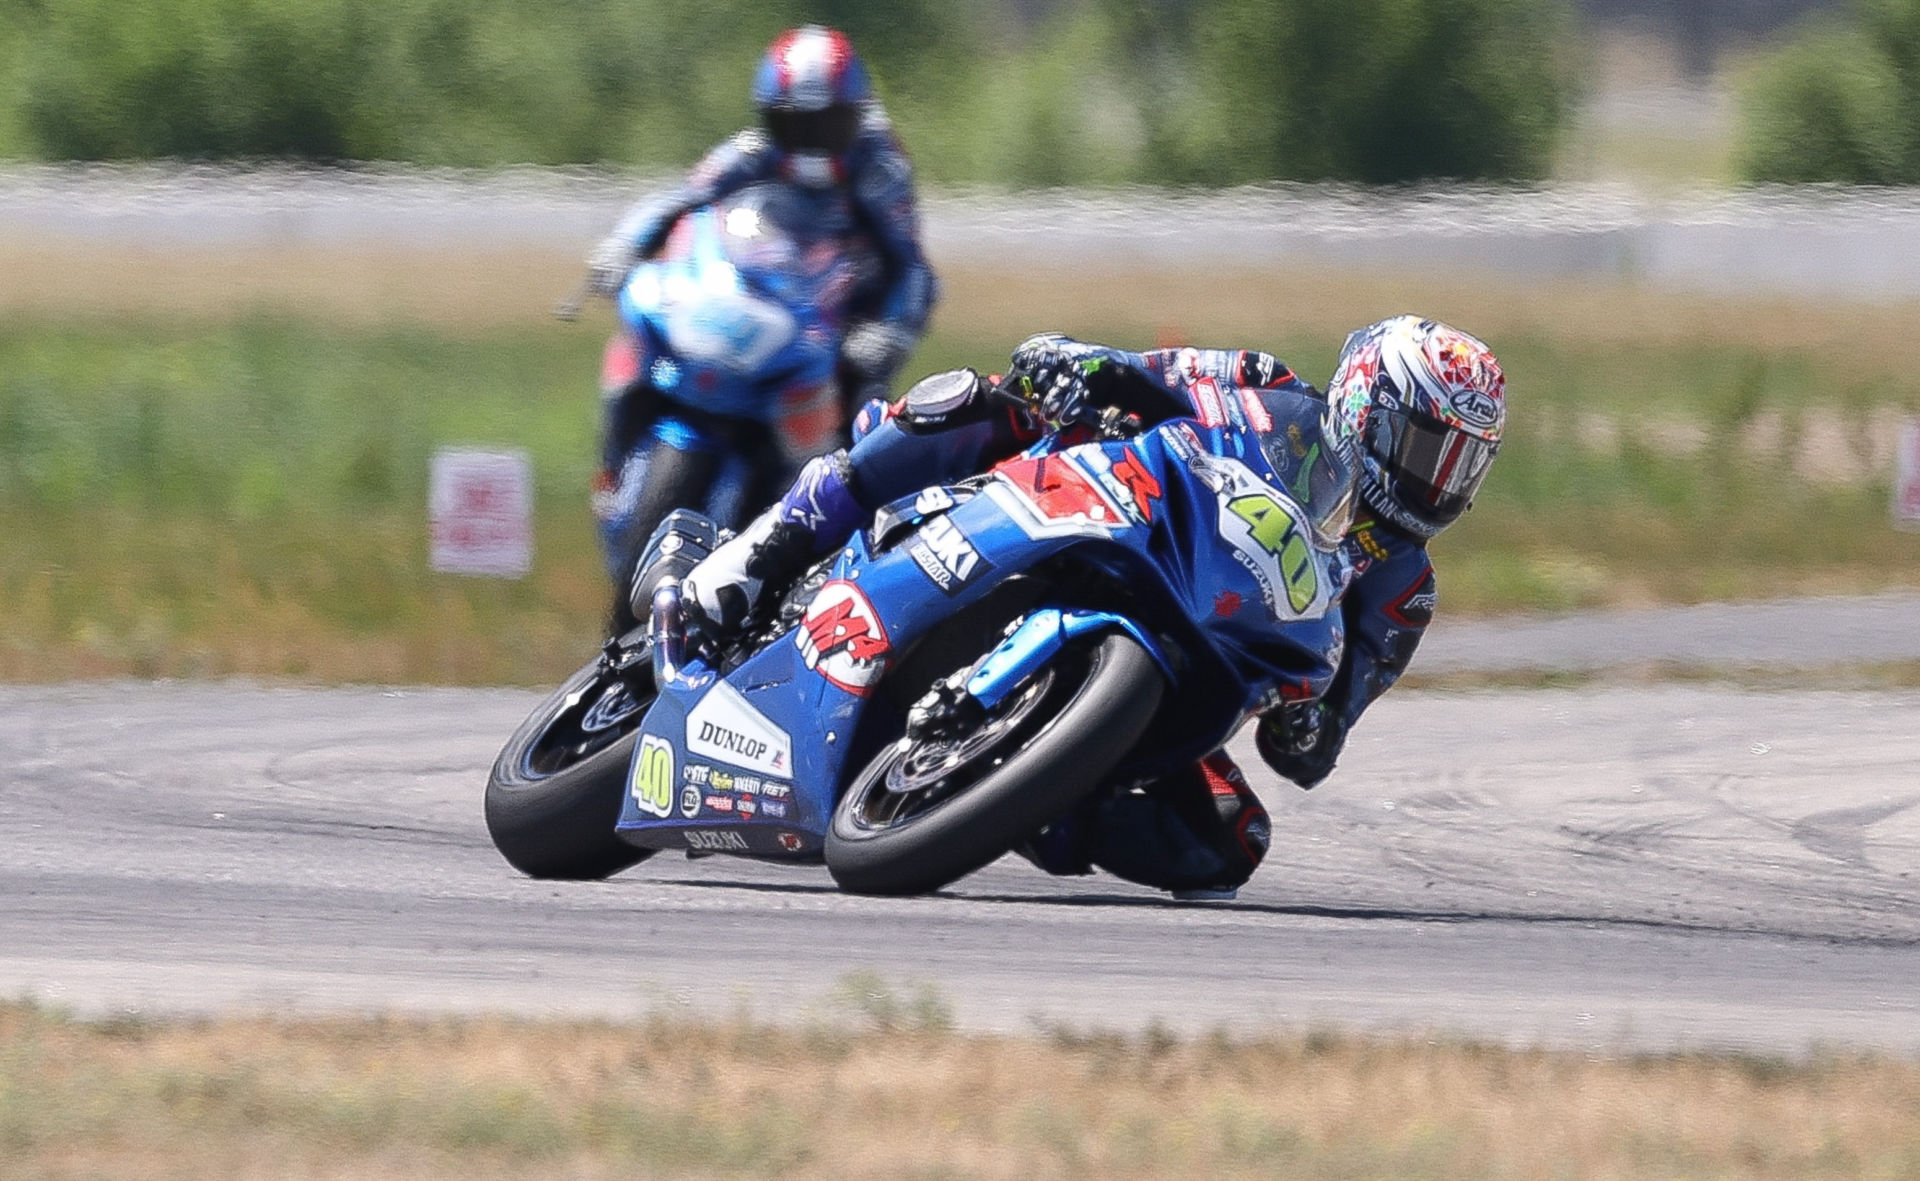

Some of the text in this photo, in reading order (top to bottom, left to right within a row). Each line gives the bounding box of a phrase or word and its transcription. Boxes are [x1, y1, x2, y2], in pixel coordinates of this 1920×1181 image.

[1226, 494, 1318, 614] 40
[1231, 548, 1276, 606] SUZUKI
[698, 720, 767, 760] DUNLOP
[635, 742, 672, 809] 40
[683, 830, 750, 850] SUZUKI
